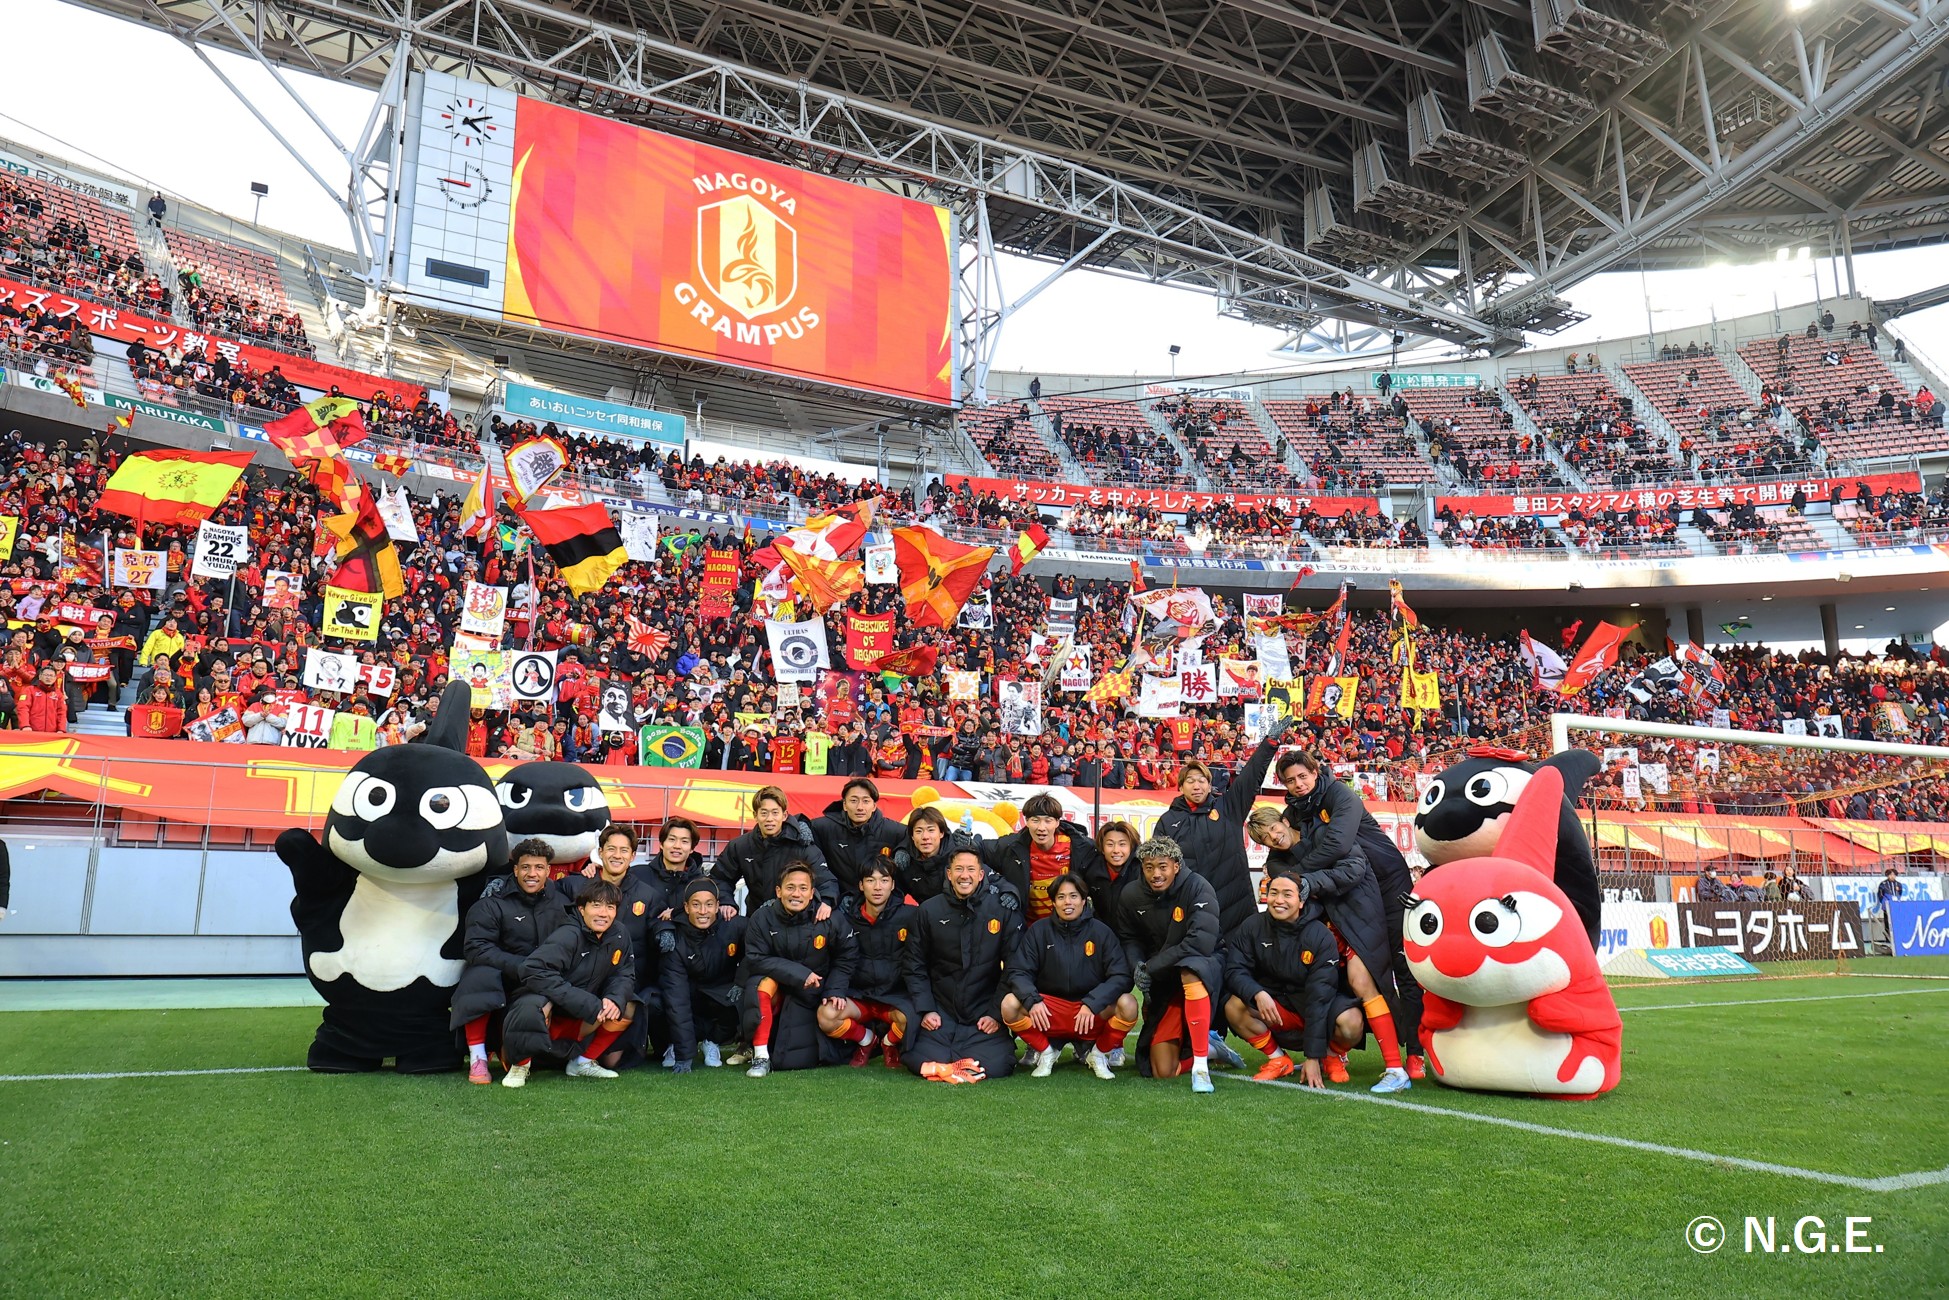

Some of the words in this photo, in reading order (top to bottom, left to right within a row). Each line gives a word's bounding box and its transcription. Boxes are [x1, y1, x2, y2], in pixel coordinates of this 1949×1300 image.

[692, 172, 797, 216] NAGOYA
[674, 282, 820, 346] GRAMPUS
[1391, 375, 1477, 387] 小松開発工業
[115, 399, 214, 430] MARUTAKA
[529, 397, 663, 432] あいおいニッセイ同和損保
[679, 508, 729, 524] FTS
[203, 532, 242, 545] GRAMPUS
[209, 527, 236, 536] NAGOYA
[208, 540, 234, 558] 22
[711, 550, 734, 559] ALLEZ
[203, 556, 238, 565] KIMURA
[1081, 554, 1134, 562] MAMEKICHI
[706, 563, 736, 572] NAGOYA
[130, 571, 153, 585] 27
[709, 577, 732, 585] ALLEZ
[349, 594, 368, 602] Give
[368, 596, 378, 604] Up
[1246, 594, 1280, 607] RISING
[327, 624, 339, 632] For
[341, 626, 354, 635] The
[862, 635, 875, 646] OF
[360, 665, 393, 688] 55
[1062, 678, 1090, 687] NAGOYA
[1181, 668, 1214, 701] 勝
[1291, 701, 1303, 718] 18
[294, 706, 325, 736] 11
[1177, 721, 1190, 734] 18
[285, 730, 329, 749] YUYA
[780, 744, 796, 758] 15
[1686, 909, 1858, 954] トヨタホーム
[1651, 952, 1748, 973] 明治安田
